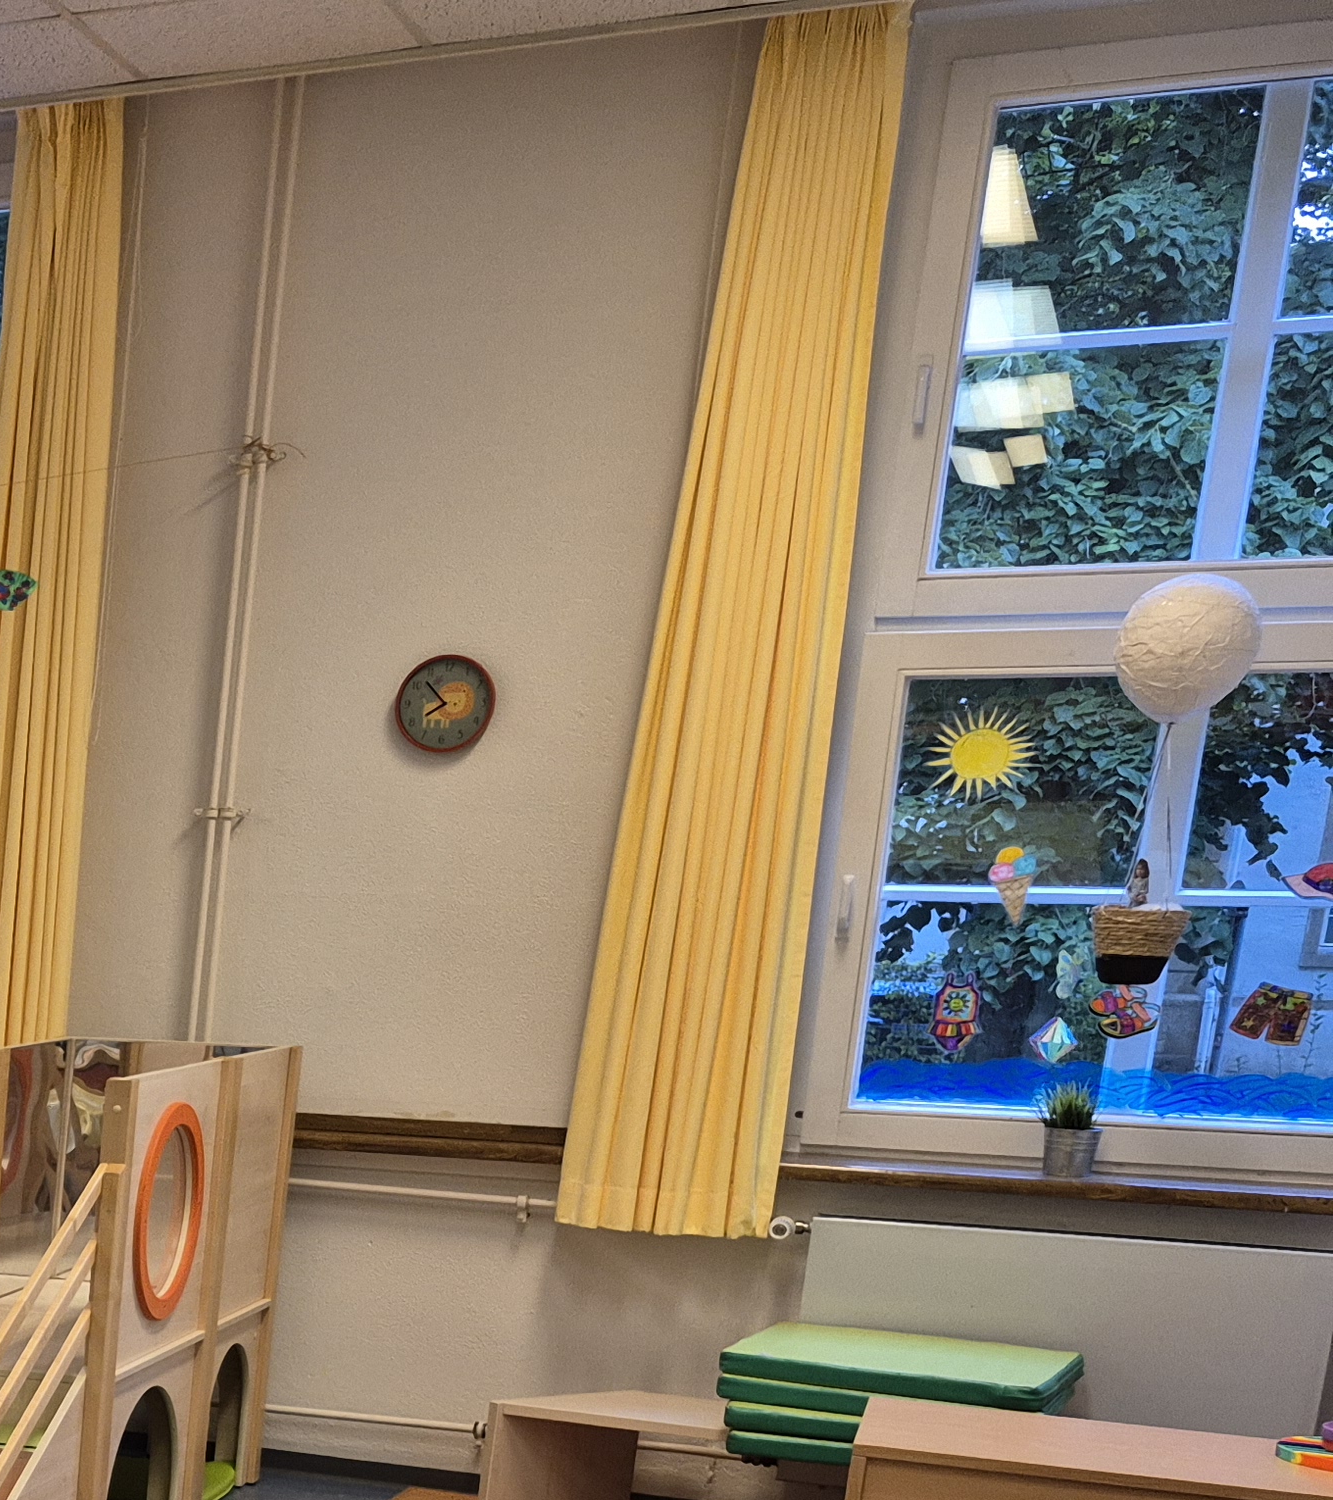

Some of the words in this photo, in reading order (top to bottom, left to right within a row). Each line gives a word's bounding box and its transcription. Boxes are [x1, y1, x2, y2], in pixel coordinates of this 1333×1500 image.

[445, 662, 455, 672] 12
[412, 681, 422, 691] 10
[404, 699, 411, 709] 9
[438, 735, 445, 744] 6
